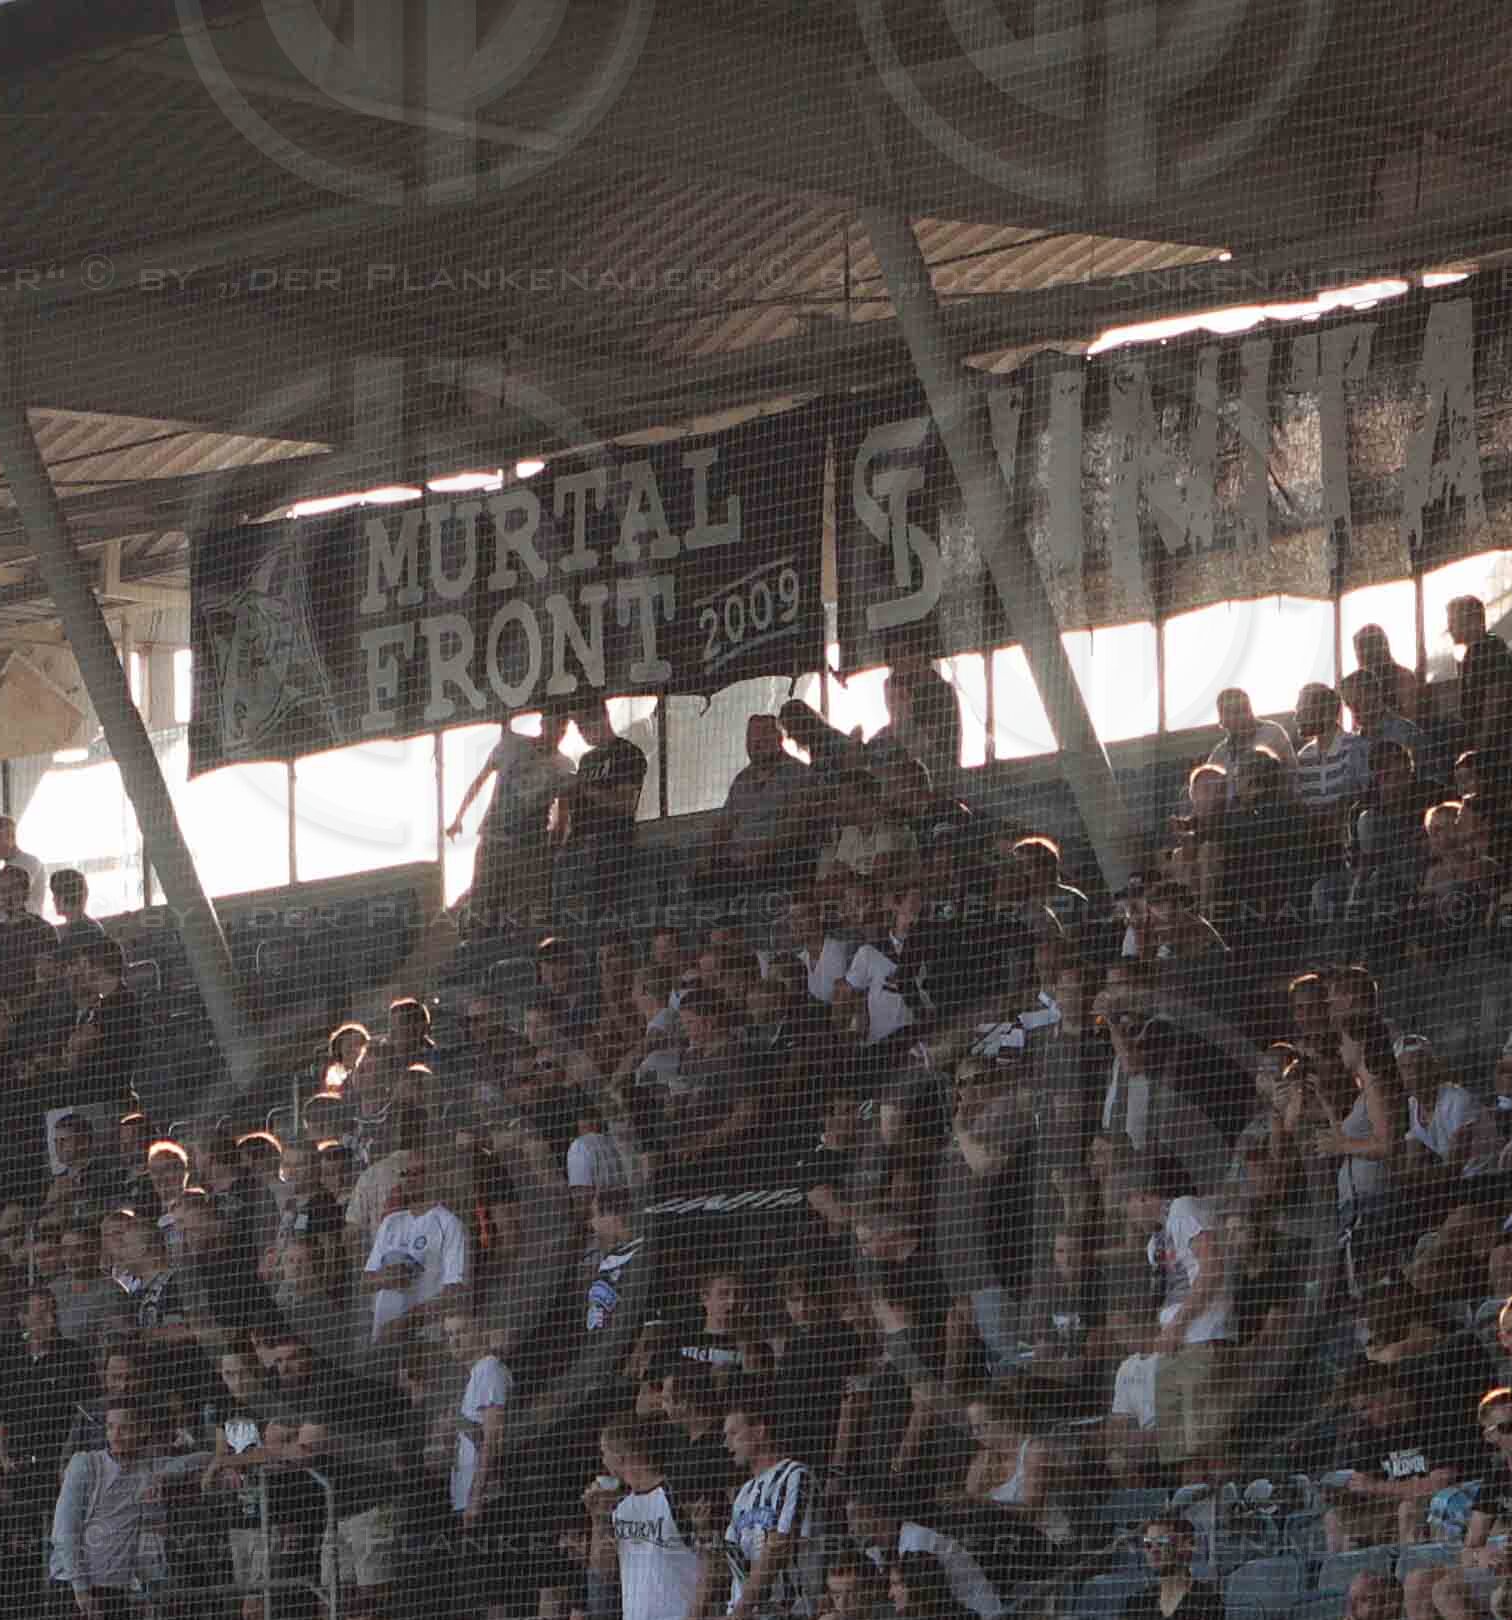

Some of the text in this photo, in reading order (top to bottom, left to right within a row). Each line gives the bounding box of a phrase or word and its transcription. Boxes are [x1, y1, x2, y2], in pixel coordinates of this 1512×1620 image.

[360, 448, 741, 614] MURTAL
[360, 575, 676, 730] FRONT
[697, 567, 800, 662] 2009
